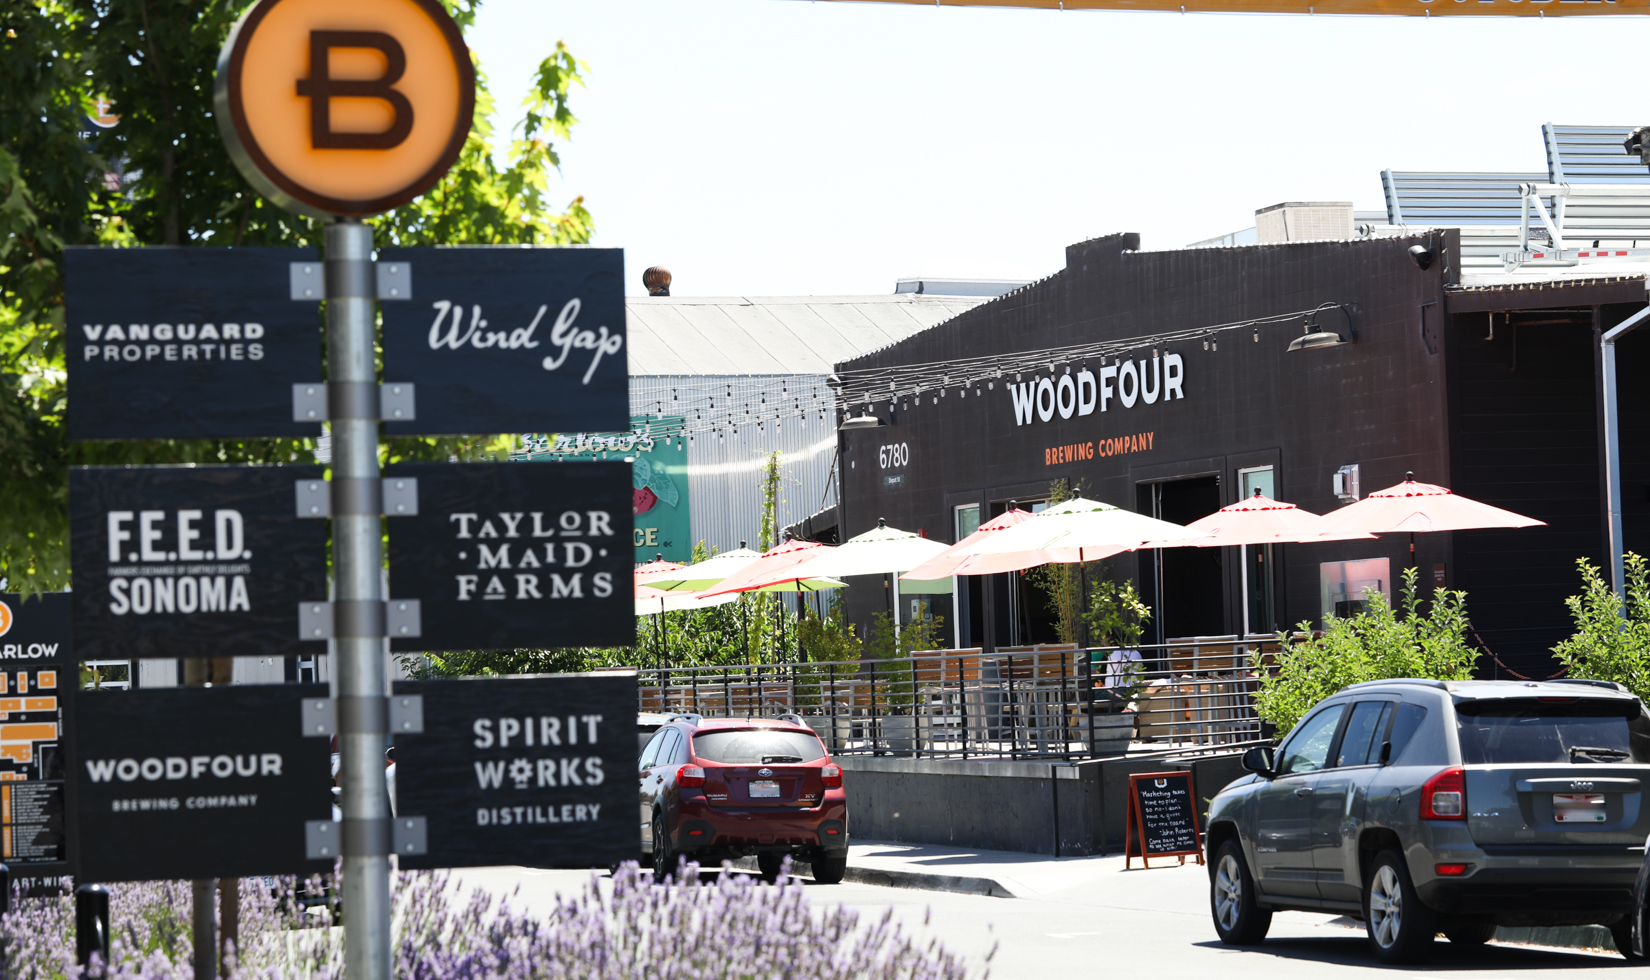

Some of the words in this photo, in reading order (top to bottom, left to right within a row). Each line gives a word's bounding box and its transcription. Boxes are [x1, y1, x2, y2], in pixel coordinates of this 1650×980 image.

[82, 322, 265, 341] VANGUARD
[428, 299, 548, 351] Wind
[542, 297, 622, 386] Gap
[84, 343, 265, 362] PROPERTIES
[1011, 353, 1185, 426] WOODFOUR
[879, 441, 909, 470] 6780
[1045, 441, 1094, 466] BREWING
[1098, 431, 1154, 458] COMPANY
[107, 509, 253, 563] F.E.E.D.
[449, 510, 615, 539] TAYLOR
[108, 575, 251, 615] SONOMA
[455, 571, 613, 601] FARMS
[473, 714, 604, 749] SPIRIT
[85, 753, 283, 783] WOODFOUR
[474, 756, 605, 790] WORKS
[1570, 780, 1595, 792] Jeep
[112, 798, 180, 812] BREWING
[185, 794, 258, 809] COMPANY
[476, 803, 601, 826] DISTILLERY
